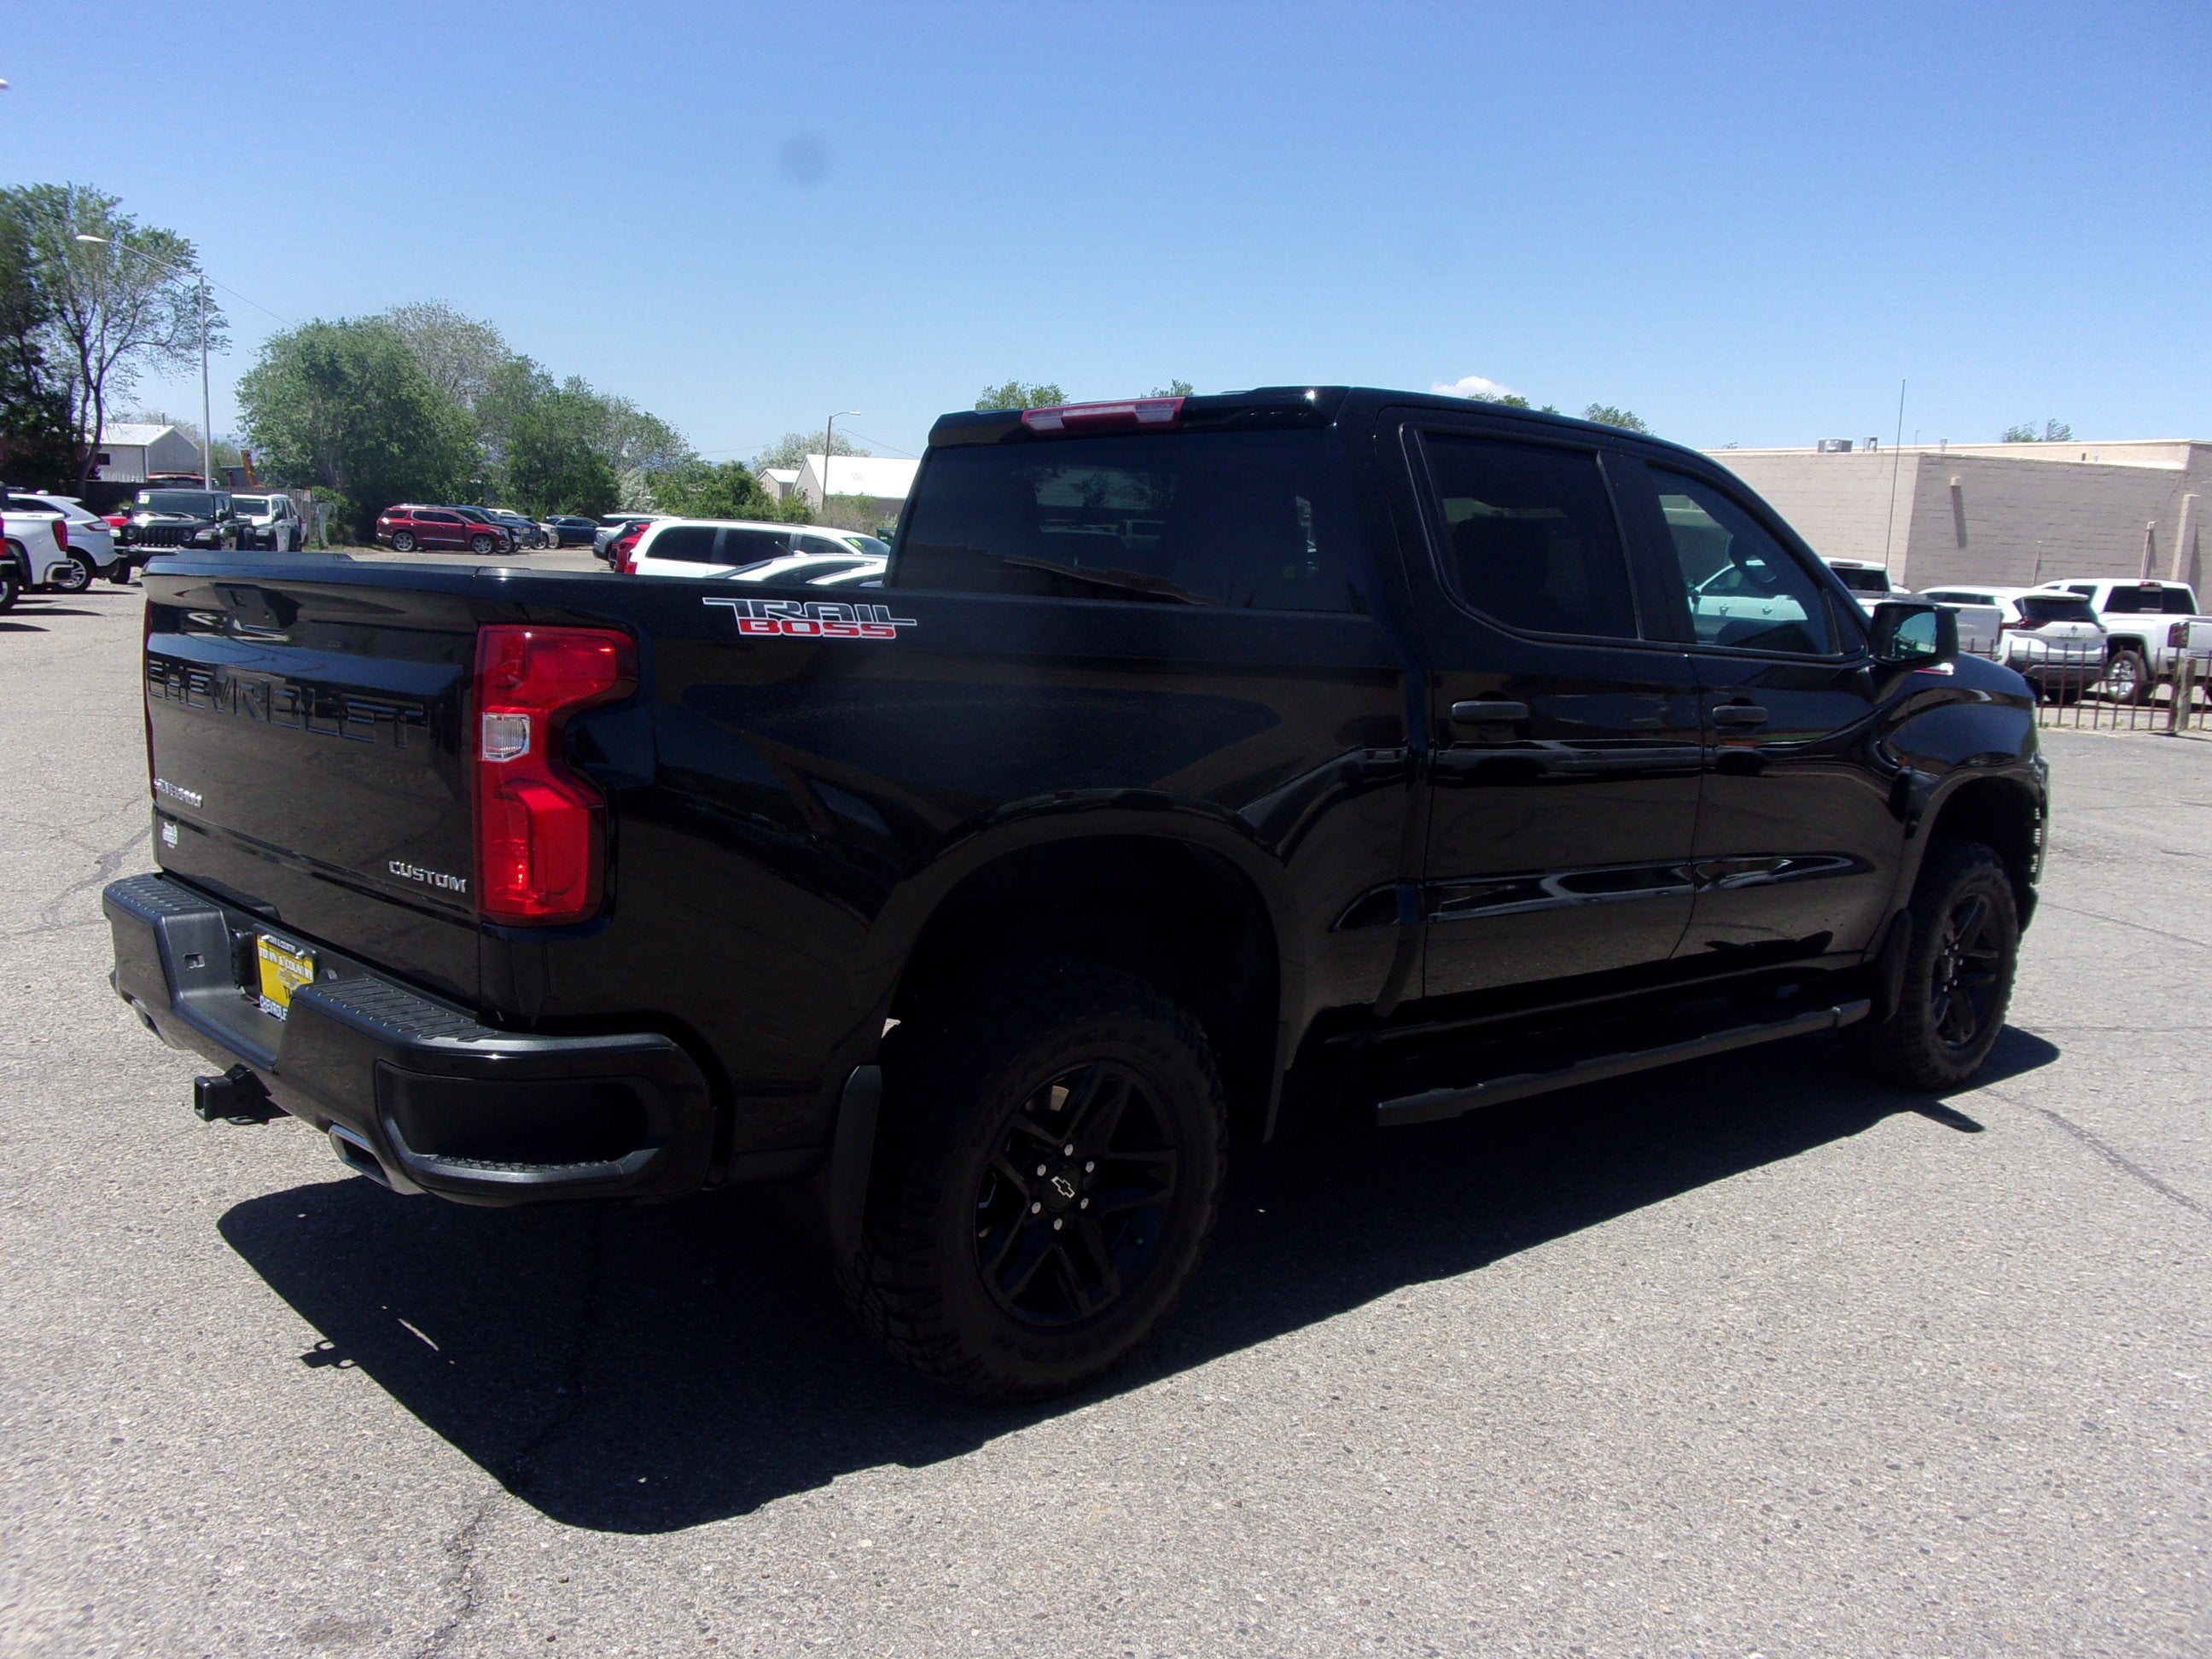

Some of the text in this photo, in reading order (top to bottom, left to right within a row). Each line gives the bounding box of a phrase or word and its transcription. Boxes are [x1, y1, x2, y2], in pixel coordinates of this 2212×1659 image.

[702, 597, 917, 626] TRAIL
[737, 617, 897, 640] BOSS
[148, 659, 428, 748] CHEVROLET
[388, 860, 467, 894] CUSTOM
[259, 995, 288, 1022] CHEVROLE
